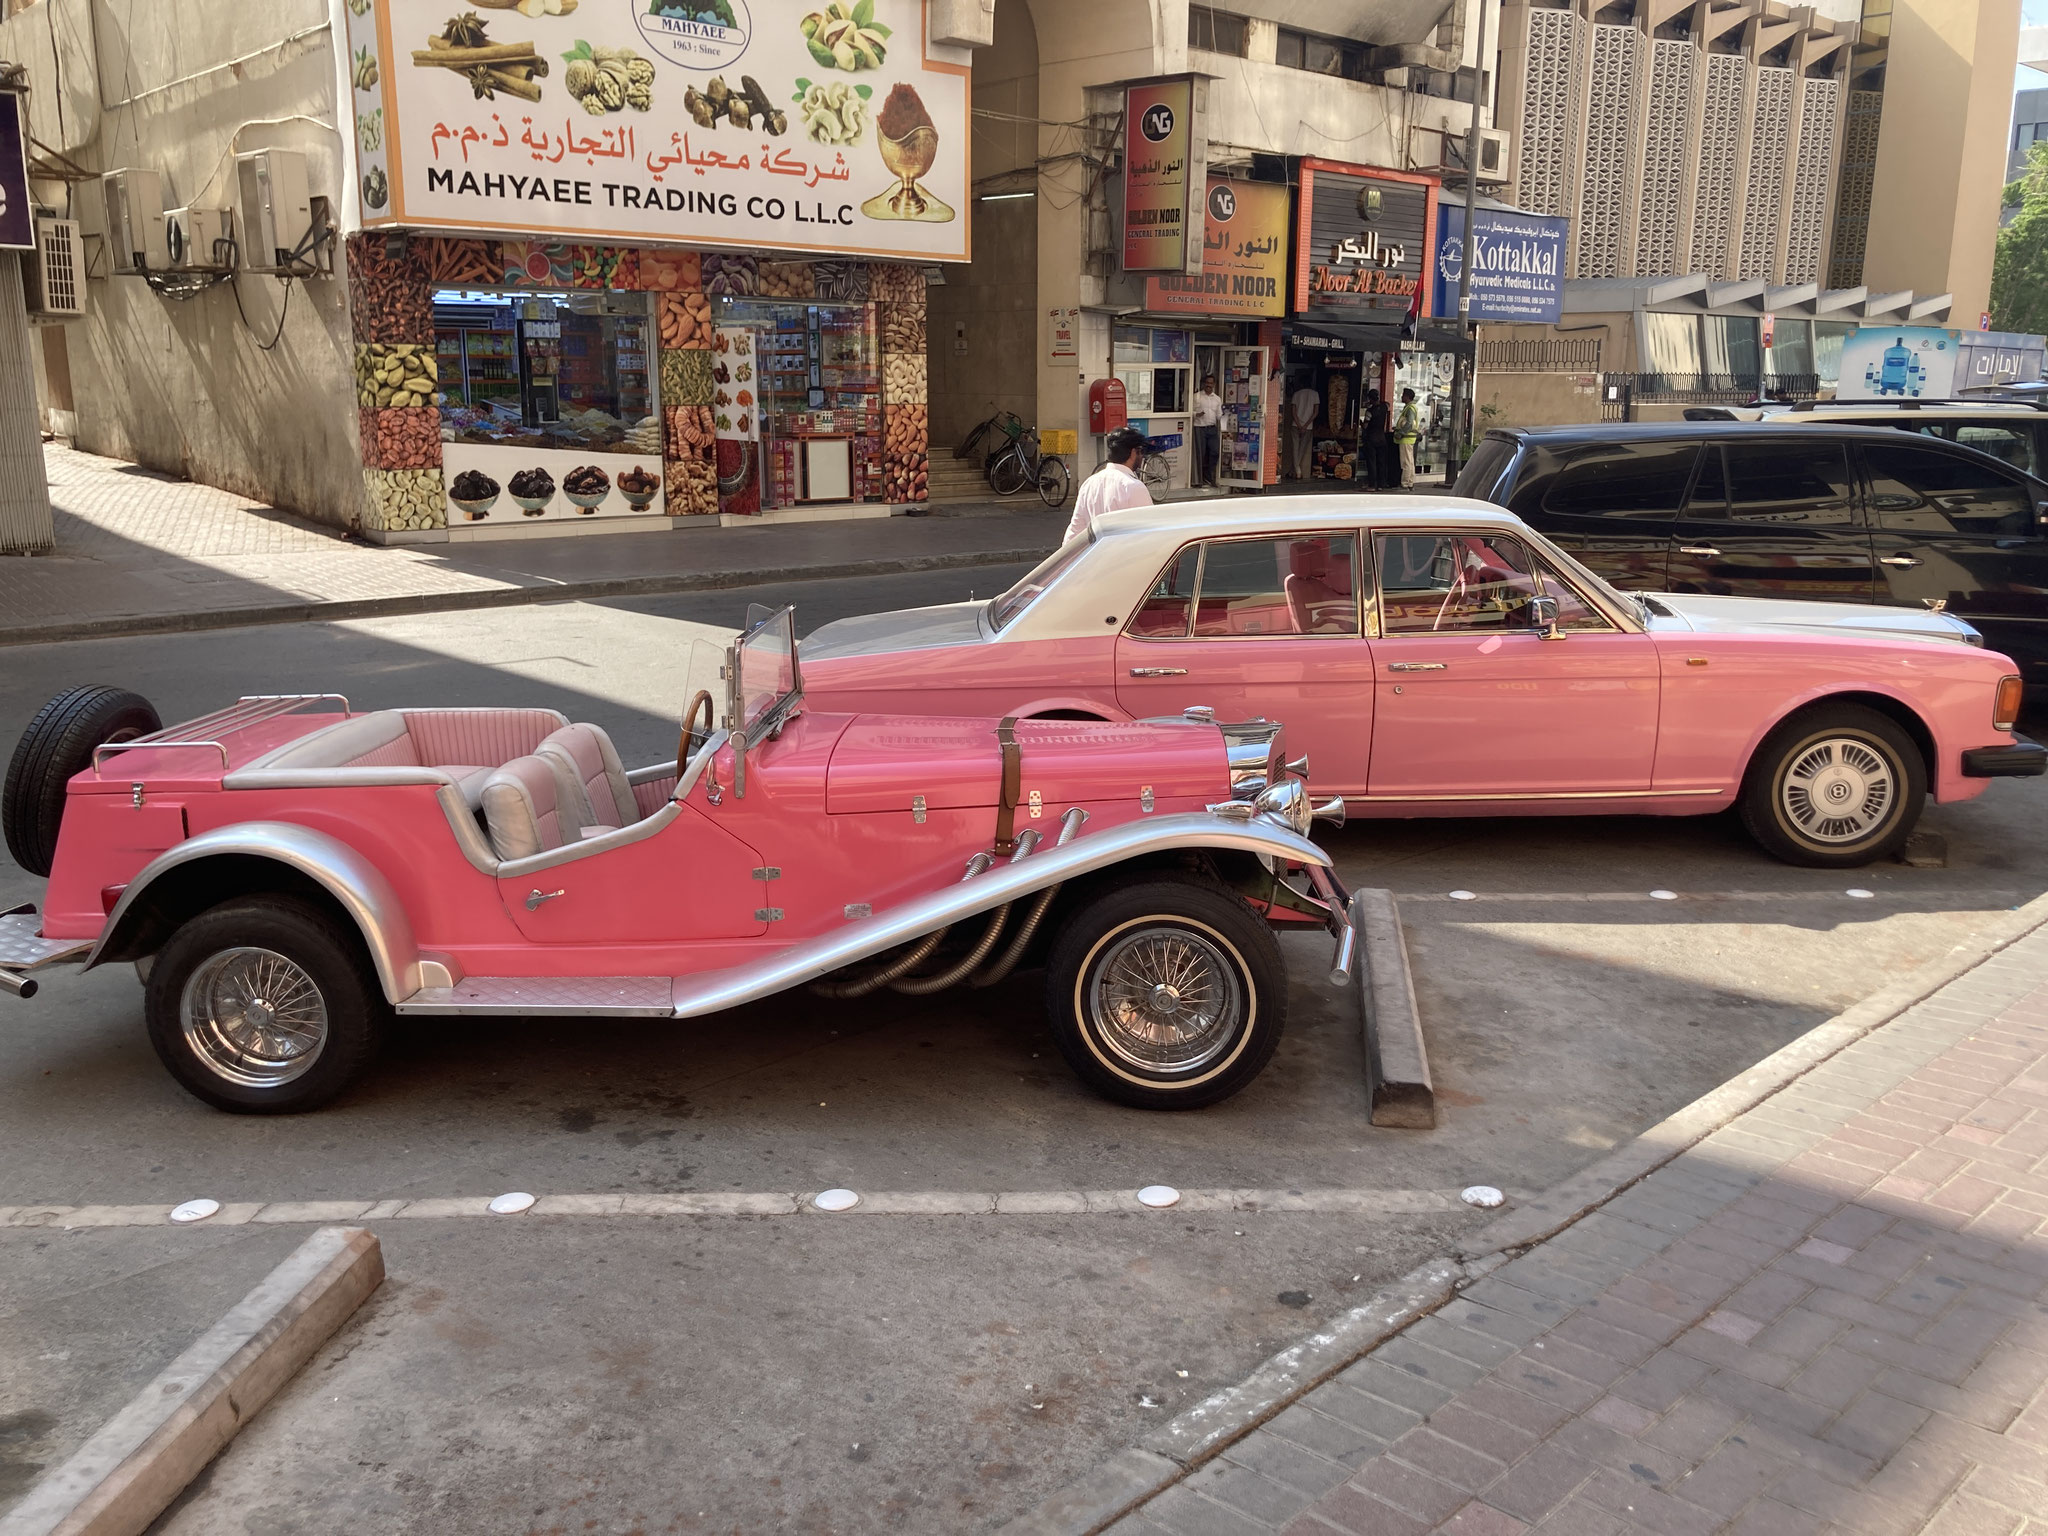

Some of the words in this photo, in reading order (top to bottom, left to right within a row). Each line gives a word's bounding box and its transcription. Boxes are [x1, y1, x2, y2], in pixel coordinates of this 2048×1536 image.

[662, 18, 726, 39] MAHYAEE
[673, 40, 692, 51] 1963
[699, 44, 721, 56] Since
[521, 116, 635, 166] التجارية
[646, 131, 750, 182] محيائي
[760, 144, 850, 188] شركة
[1162, 158, 1183, 175] النور
[428, 167, 592, 205] MAHYAEE
[603, 183, 737, 216] TRADING
[747, 196, 786, 220] CO
[795, 200, 854, 225] L.L.C
[1159, 208, 1180, 224] NOOR
[1128, 229, 1153, 238] GENERAL
[1155, 228, 1180, 237] TRADING
[1233, 235, 1278, 258] النور
[1335, 231, 1378, 265] البكر
[1382, 244, 1405, 267] نور
[1471, 235, 1557, 276] Kottakkal
[1159, 272, 1228, 295] GOLDEN
[1232, 274, 1276, 297] NOOR
[1315, 266, 1352, 292] Noor
[1354, 268, 1373, 293] Al
[1469, 273, 1502, 288] Ayurvedic
[1504, 276, 1531, 290] Medicals
[1167, 295, 1205, 304] GENERAL
[1209, 298, 1244, 307] TRADING
[1292, 335, 1300, 345] TEA
[1303, 336, 1328, 347] SHAWARMA
[1331, 339, 1344, 349] GRILL
[1977, 353, 2024, 382] الإمارات
